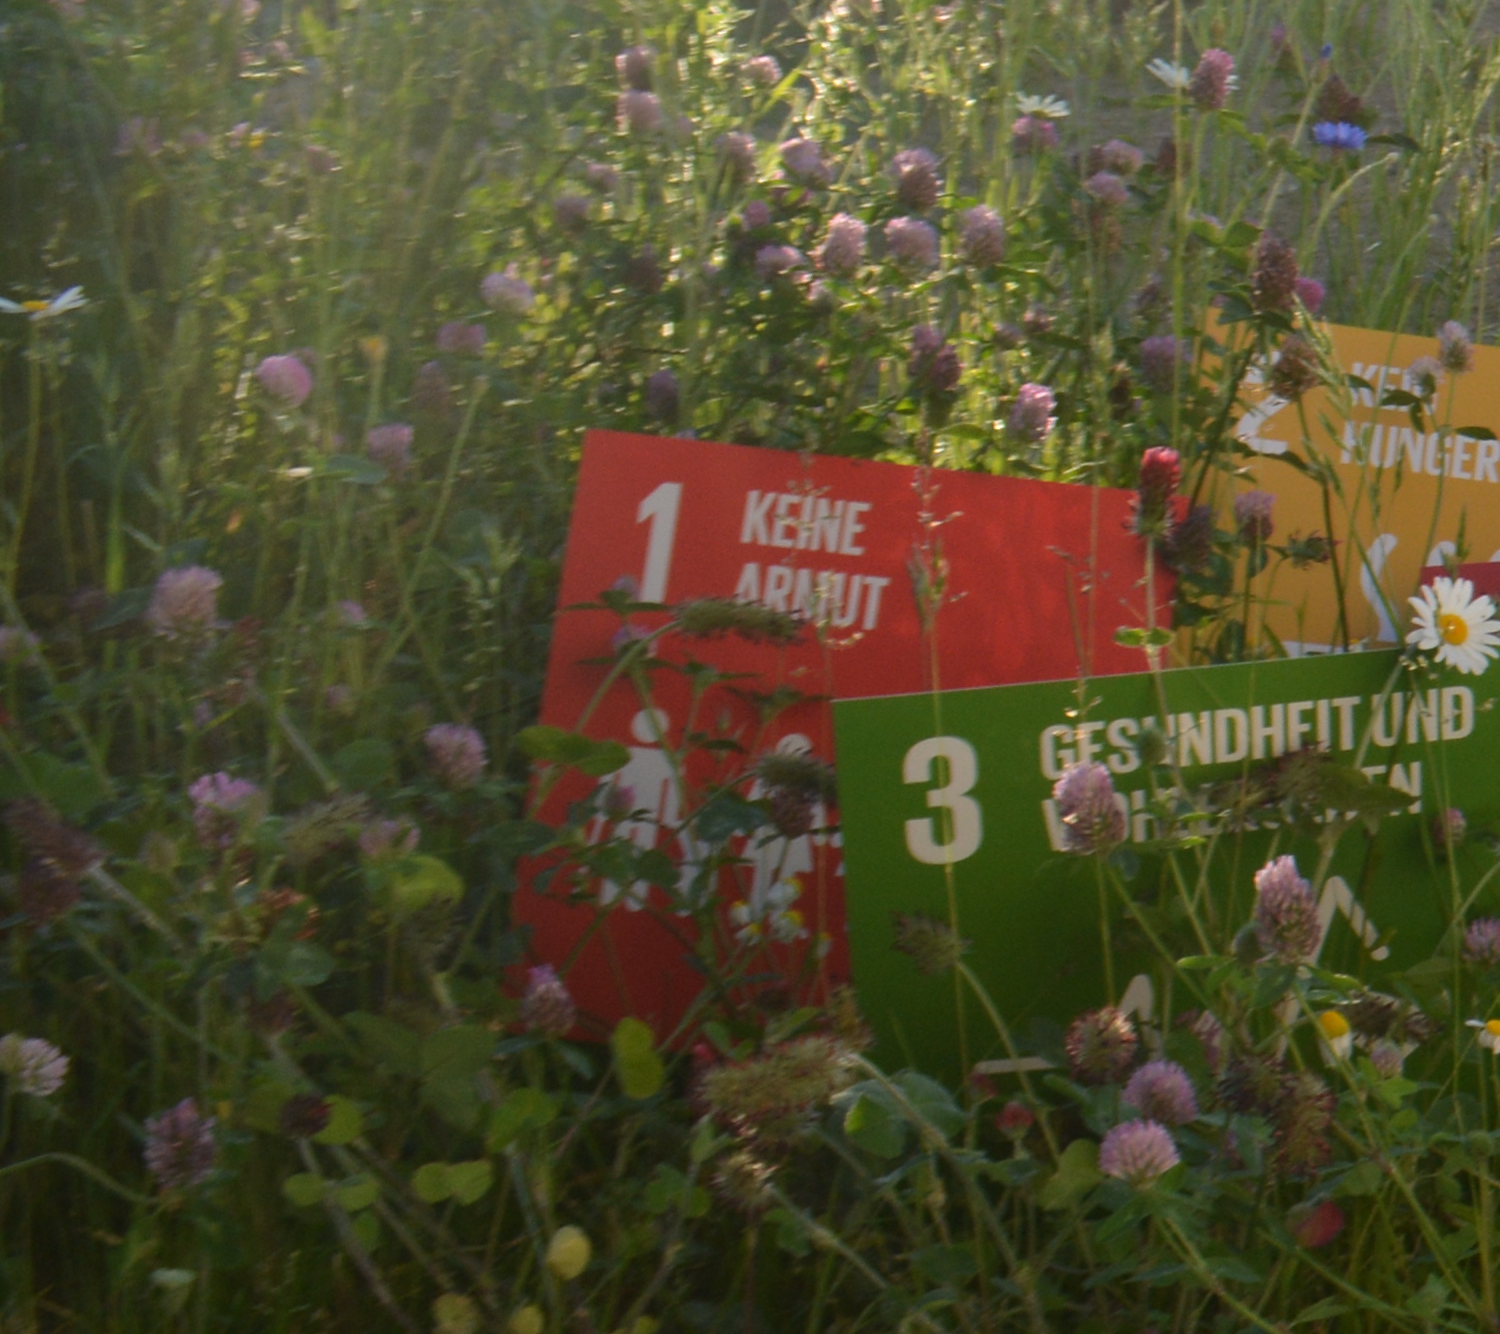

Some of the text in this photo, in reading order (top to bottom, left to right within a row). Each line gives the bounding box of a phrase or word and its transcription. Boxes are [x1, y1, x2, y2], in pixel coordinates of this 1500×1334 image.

[636, 481, 873, 604] 1 KEINE
[902, 734, 984, 866] 3
[1371, 684, 1476, 747] UND
